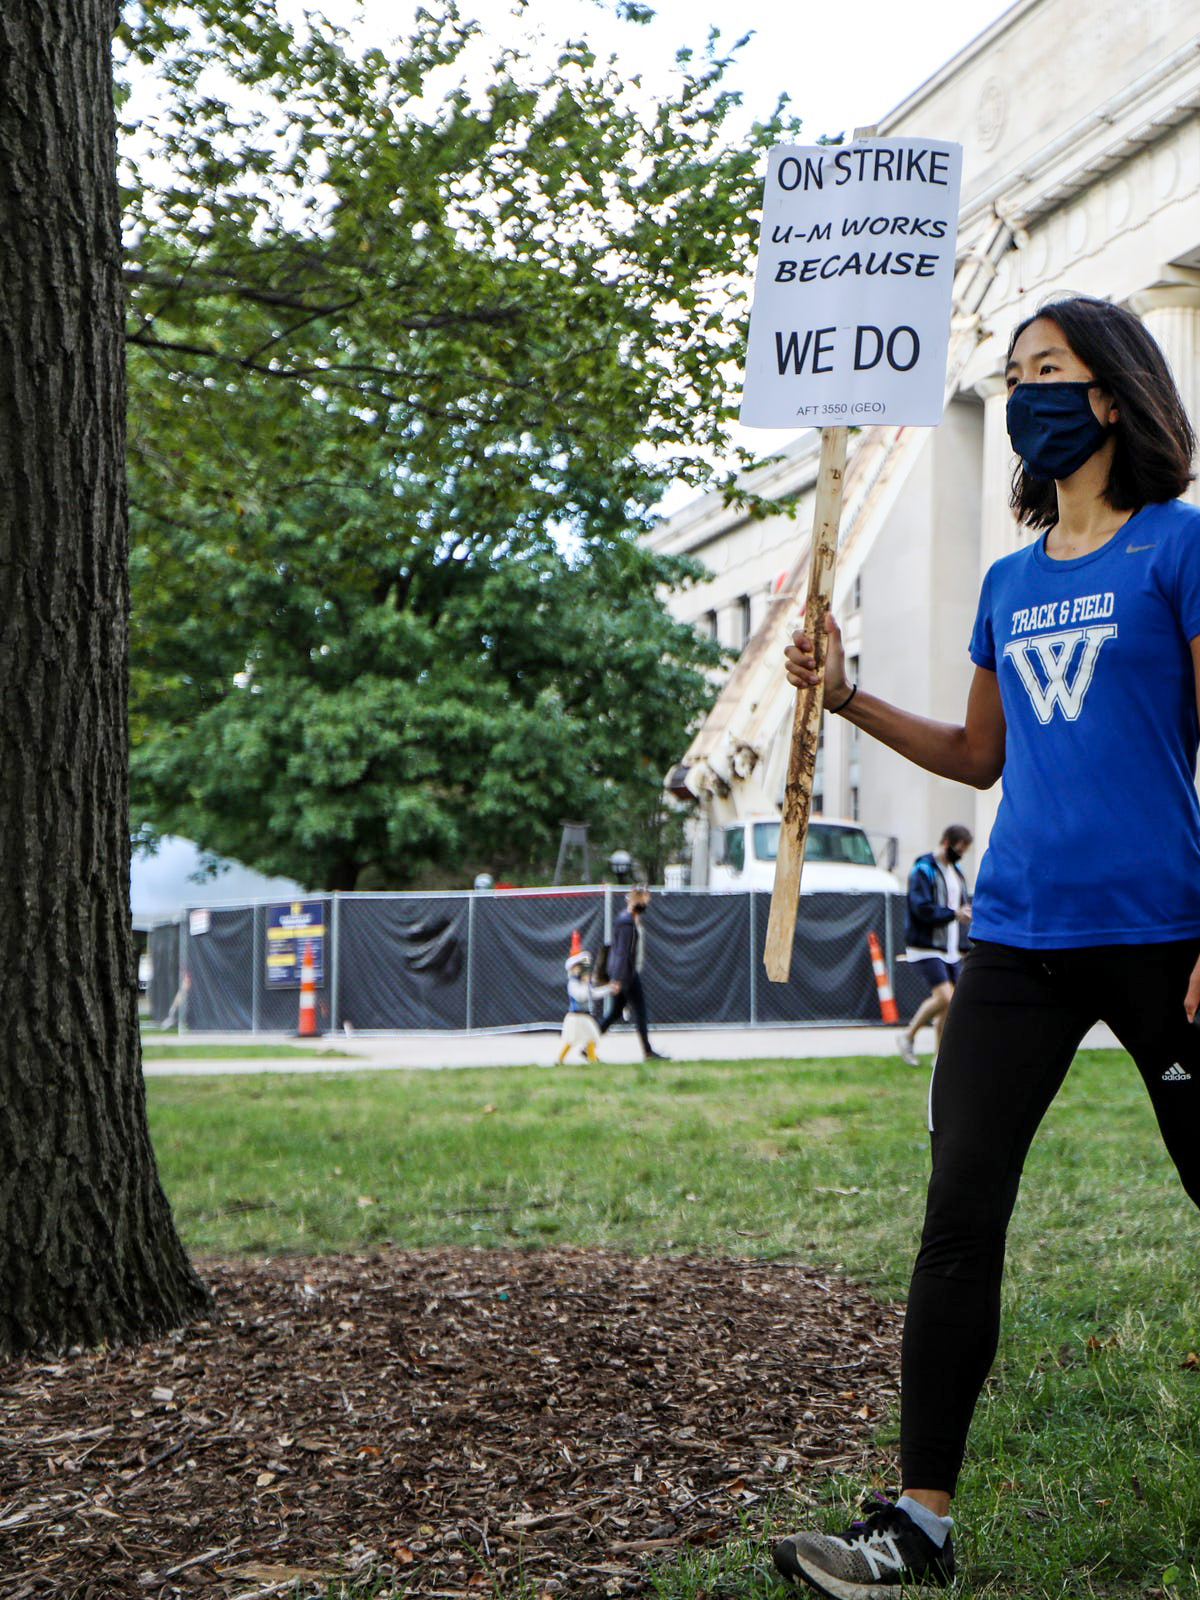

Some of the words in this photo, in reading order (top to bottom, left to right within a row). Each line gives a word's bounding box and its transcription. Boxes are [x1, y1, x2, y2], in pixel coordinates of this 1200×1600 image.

[777, 156, 824, 191] ON
[833, 148, 950, 187] STRIKE
[771, 222, 832, 243] U-M
[841, 216, 948, 238] WORKS
[774, 252, 940, 283] BECAUSE
[775, 326, 837, 375] WE
[853, 325, 920, 372] DO
[796, 405, 819, 417] AFT
[822, 403, 848, 415] 3550
[850, 402, 886, 415] (GEO)
[1010, 602, 1058, 636] TRACK
[1059, 600, 1070, 625] &
[1071, 592, 1115, 623] FIELD
[1003, 624, 1118, 725] W
[1161, 1073, 1192, 1081] adidas
